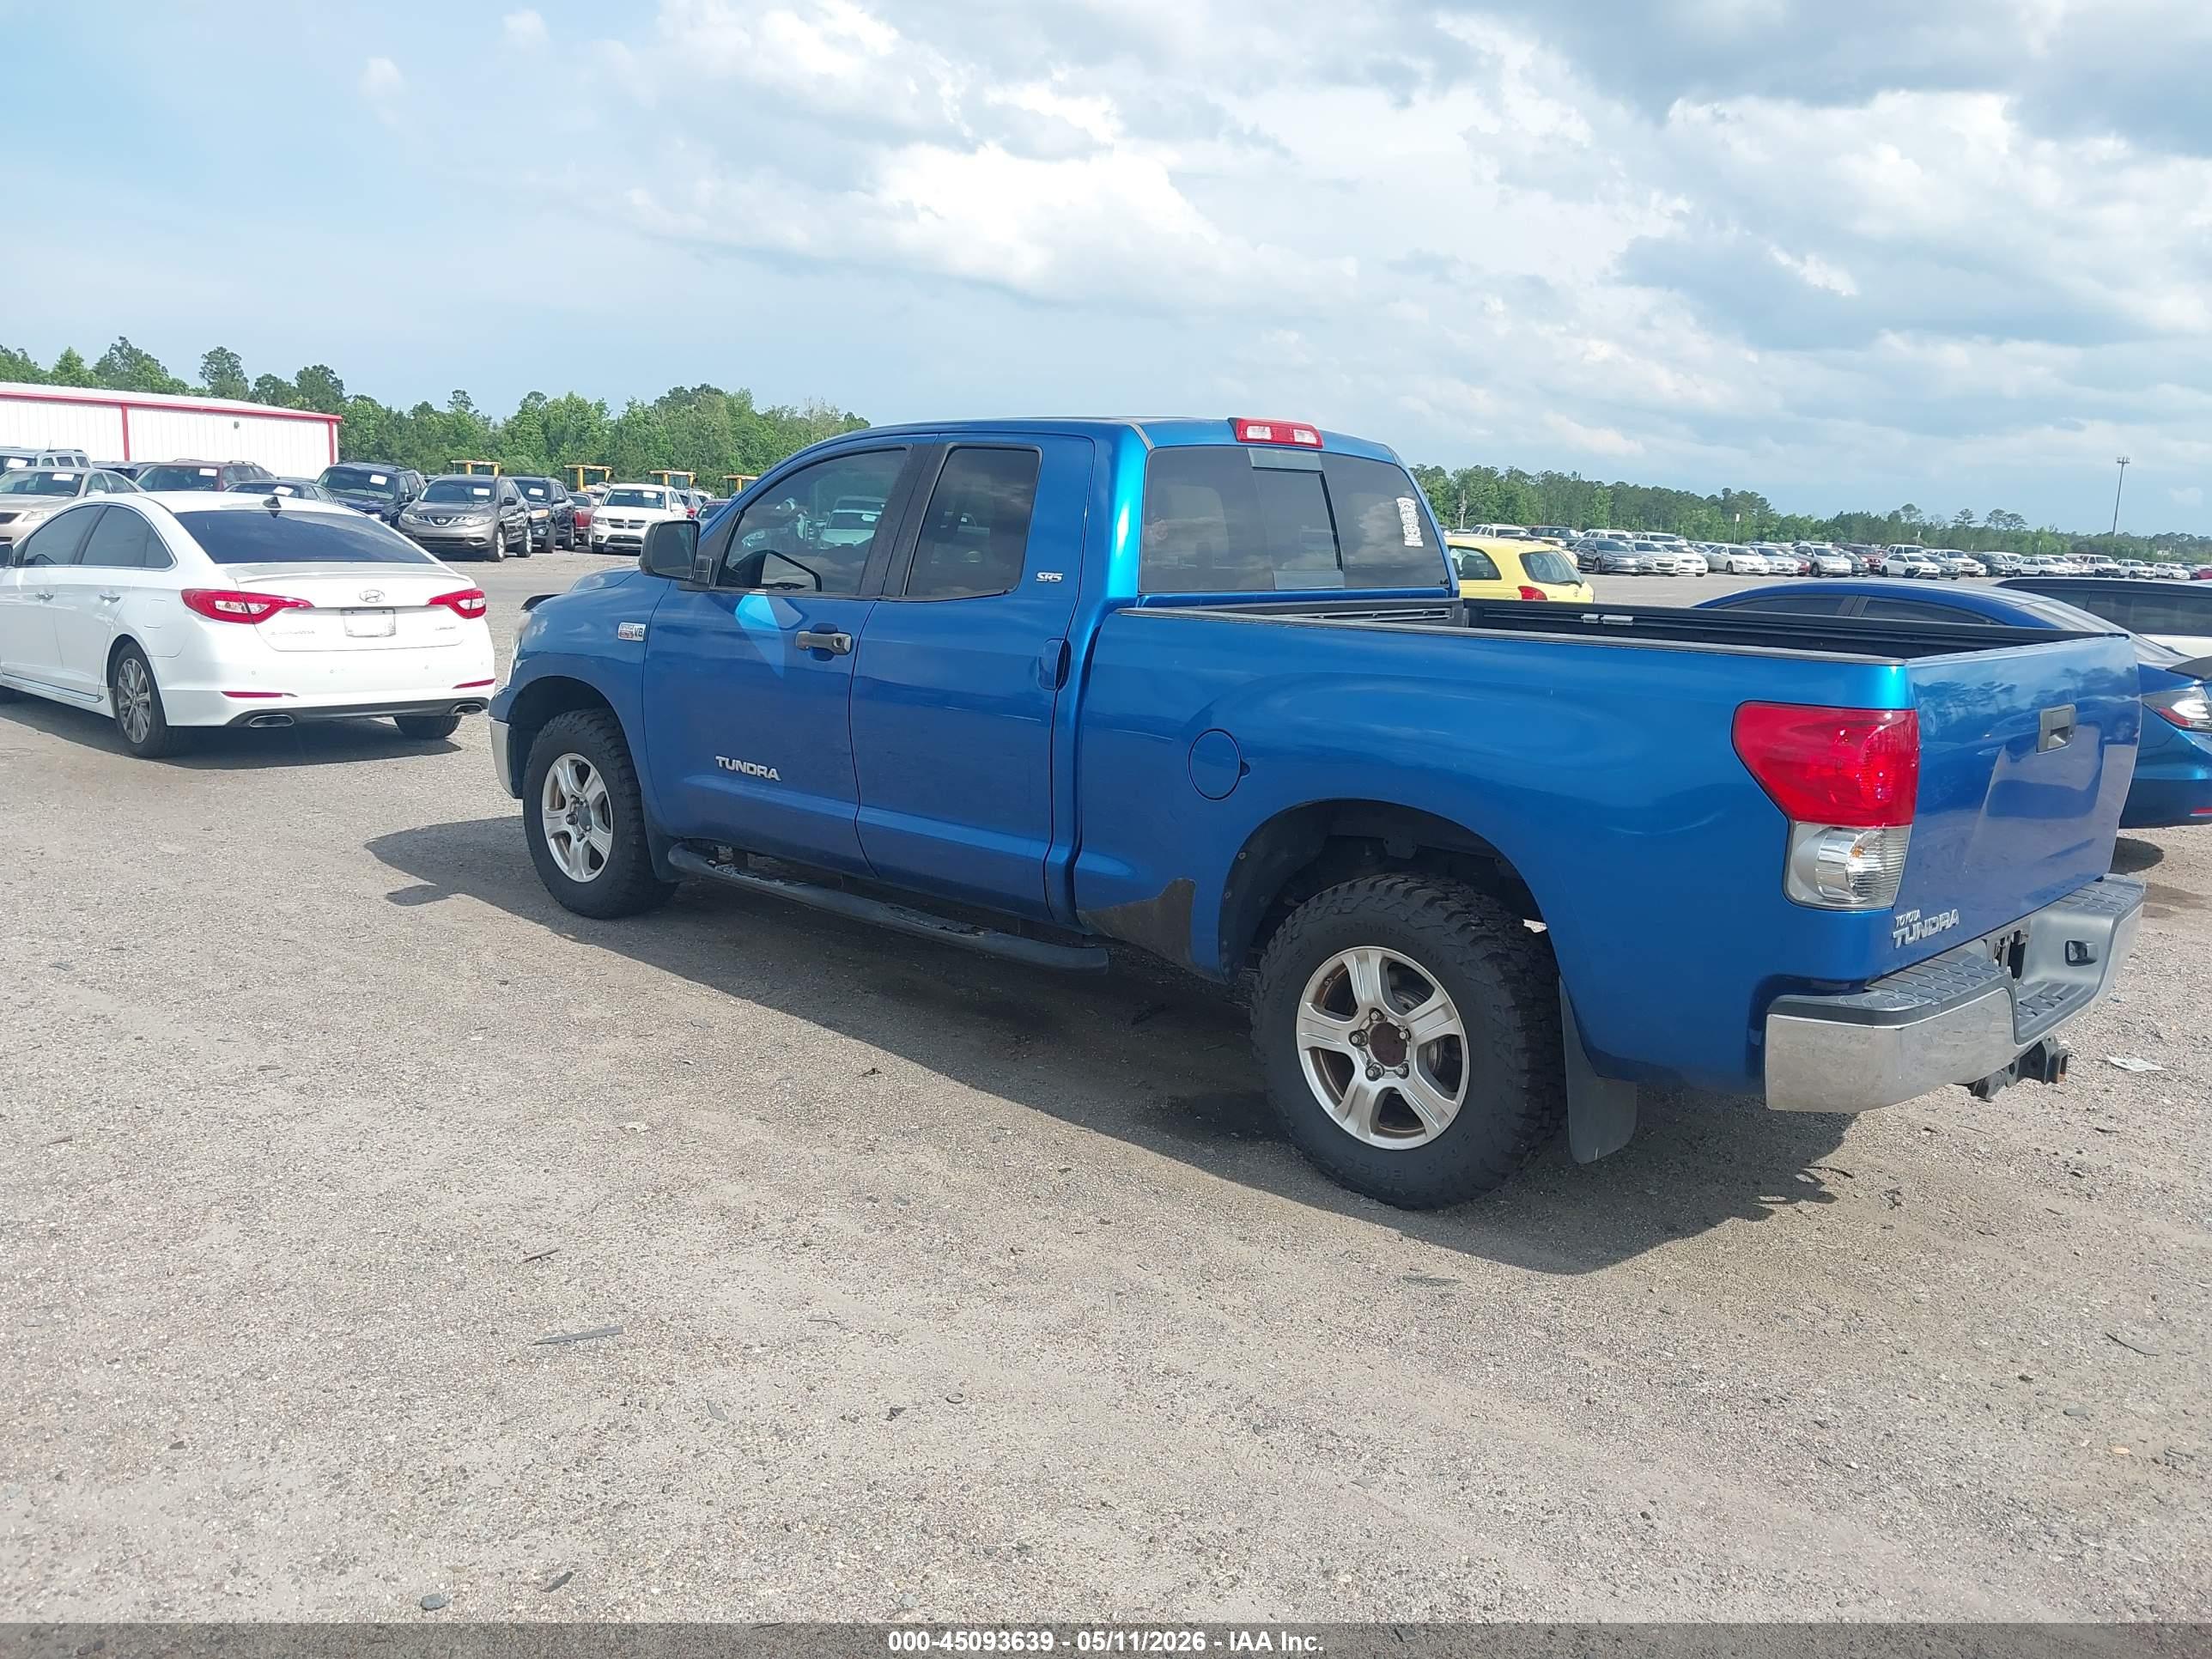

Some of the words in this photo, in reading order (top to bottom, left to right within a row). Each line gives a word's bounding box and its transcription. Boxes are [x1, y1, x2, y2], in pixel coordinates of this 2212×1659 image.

[1036, 572, 1064, 583] SR5
[714, 755, 781, 781] TUNDRA
[1893, 908, 1960, 949] TUNDRA
[1895, 908, 1921, 928] TOYOTA
